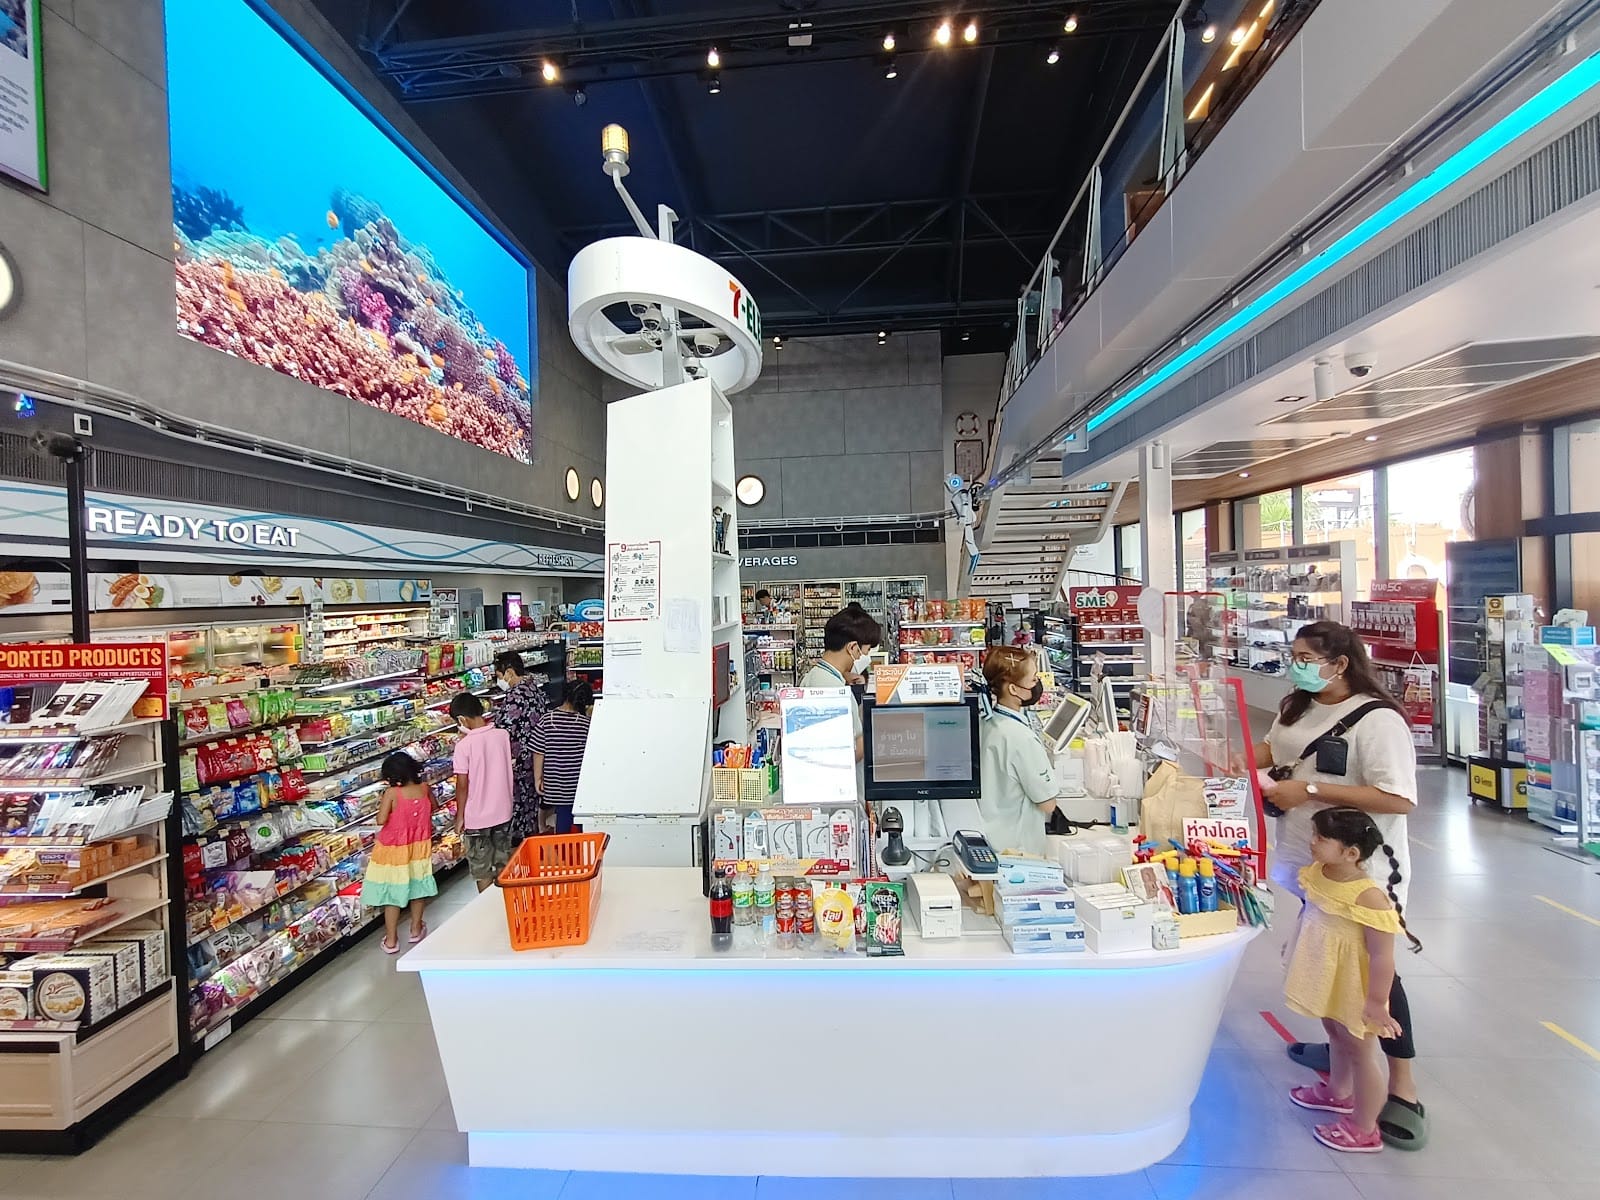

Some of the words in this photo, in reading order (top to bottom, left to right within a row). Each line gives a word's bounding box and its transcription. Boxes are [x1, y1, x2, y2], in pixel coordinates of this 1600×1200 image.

[87, 507, 205, 540] READY
[213, 520, 249, 544] TO
[255, 524, 300, 547] EAT
[620, 543, 627, 552] 9
[1076, 596, 1106, 607] SME
[69, 648, 162, 667] PRODUCTS
[1187, 820, 1247, 839] ห่างไกล
